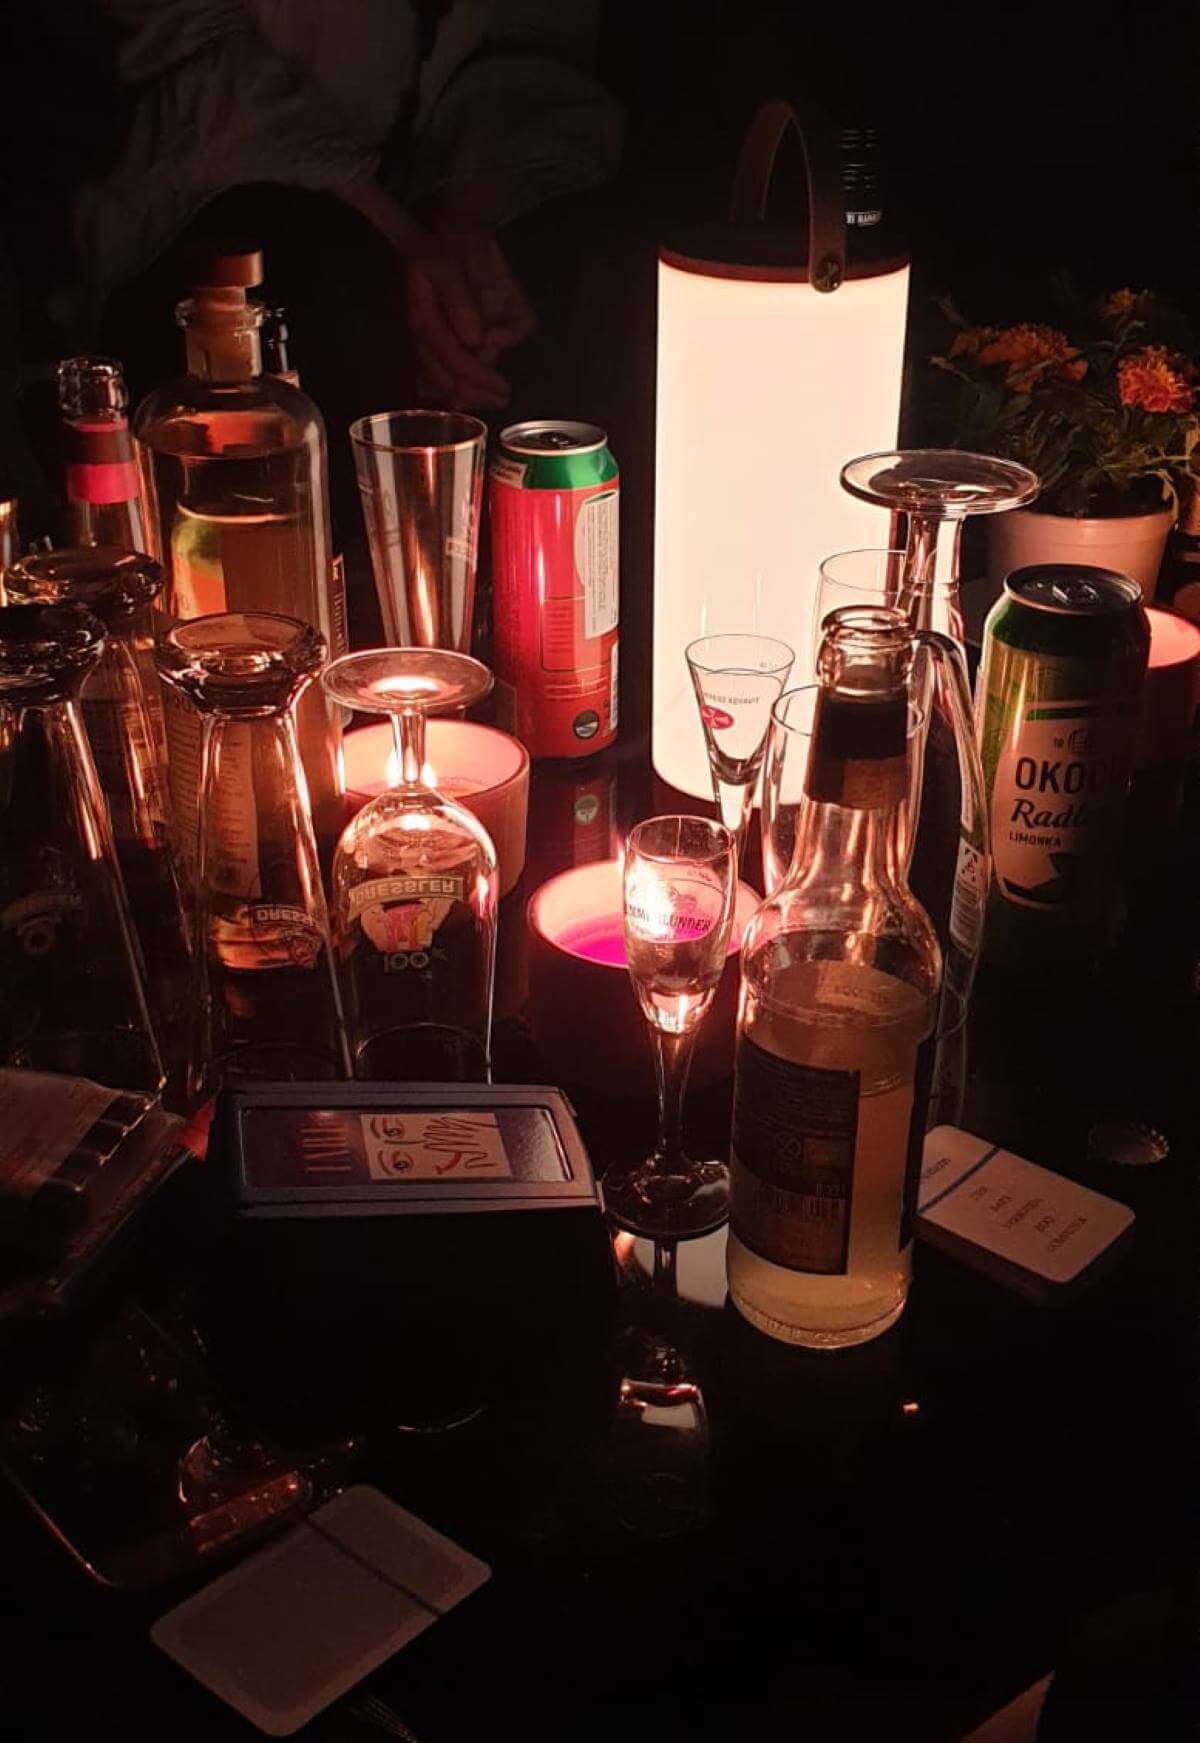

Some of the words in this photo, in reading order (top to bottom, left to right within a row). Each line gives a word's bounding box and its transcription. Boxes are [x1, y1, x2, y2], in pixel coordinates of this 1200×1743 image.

[1016, 757, 1088, 795] OKO
[1010, 798, 1086, 828] Radl
[1009, 831, 1062, 847] LIMONKA
